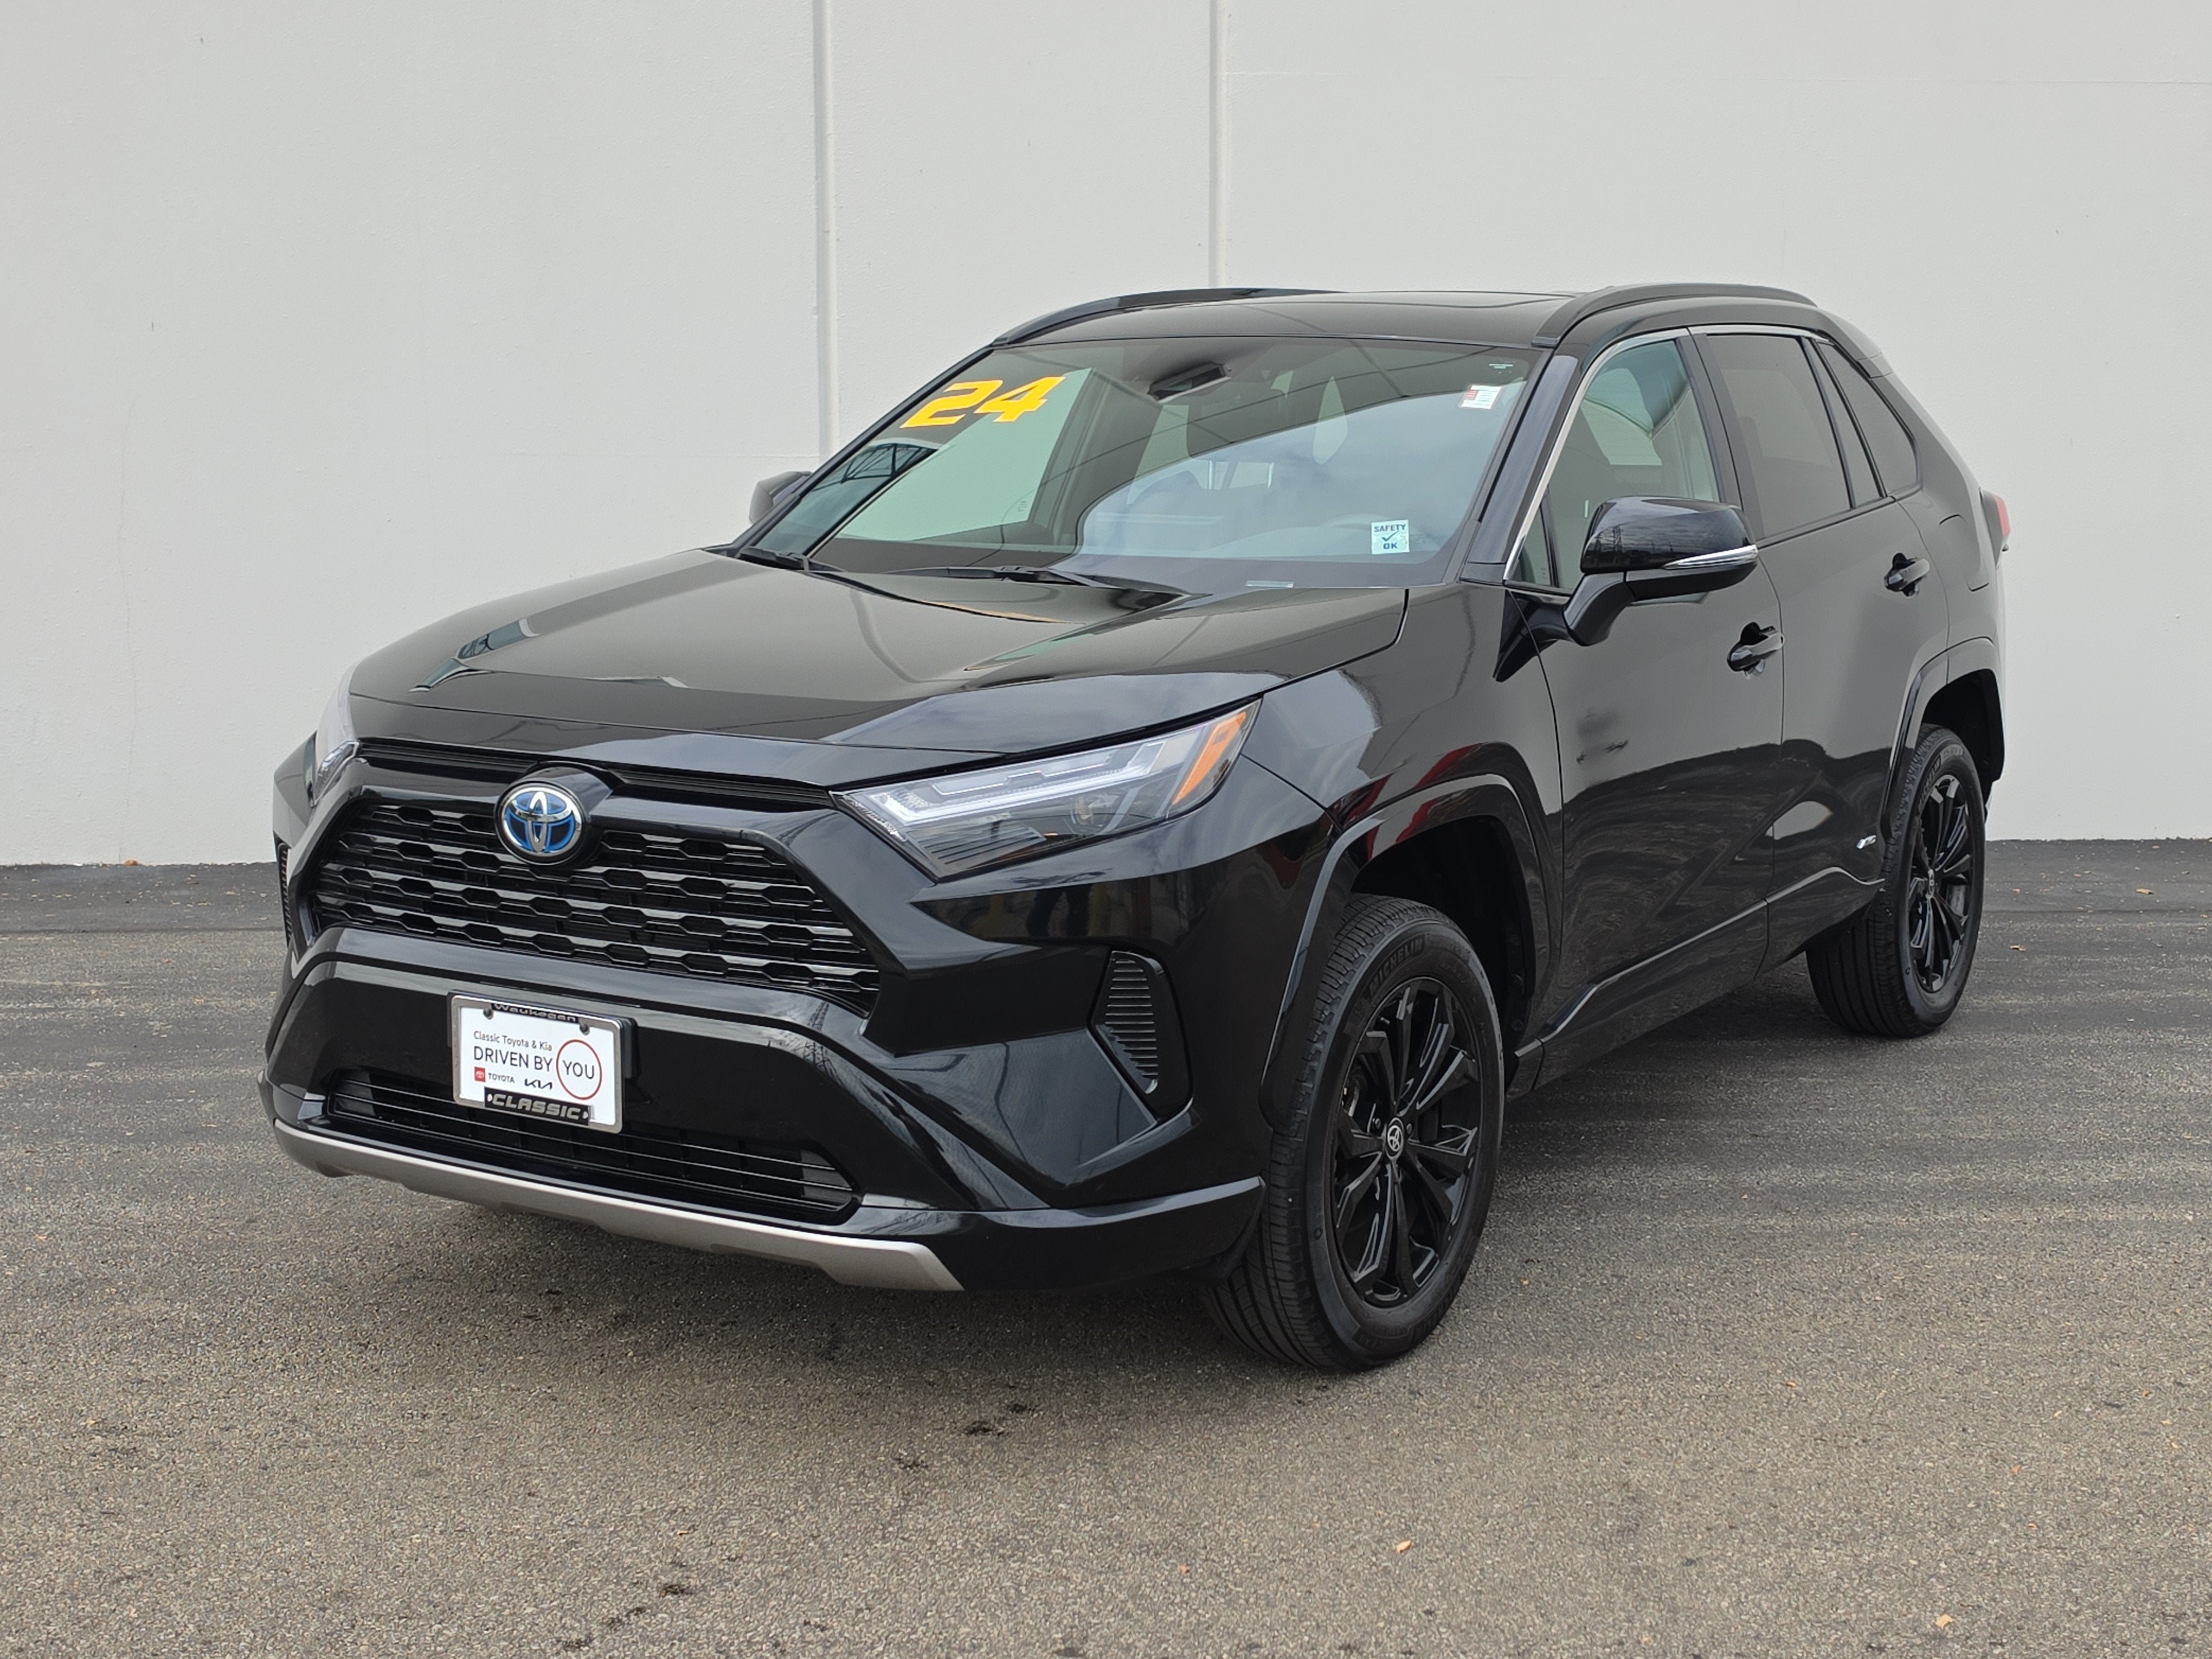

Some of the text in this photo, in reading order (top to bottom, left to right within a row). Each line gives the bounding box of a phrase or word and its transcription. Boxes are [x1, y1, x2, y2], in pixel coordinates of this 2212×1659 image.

[899, 376, 1065, 428] 24
[1374, 524, 1406, 532] SAFETY
[1369, 937, 1423, 995] MICHELIN
[494, 1004, 576, 1022] Waukegan
[474, 1031, 552, 1051] Classic Toyota & Kia
[474, 1046, 594, 1079] DRIVEN BY YOU
[488, 1072, 515, 1083] TOYOTA
[492, 1094, 581, 1120] CLASSIC
